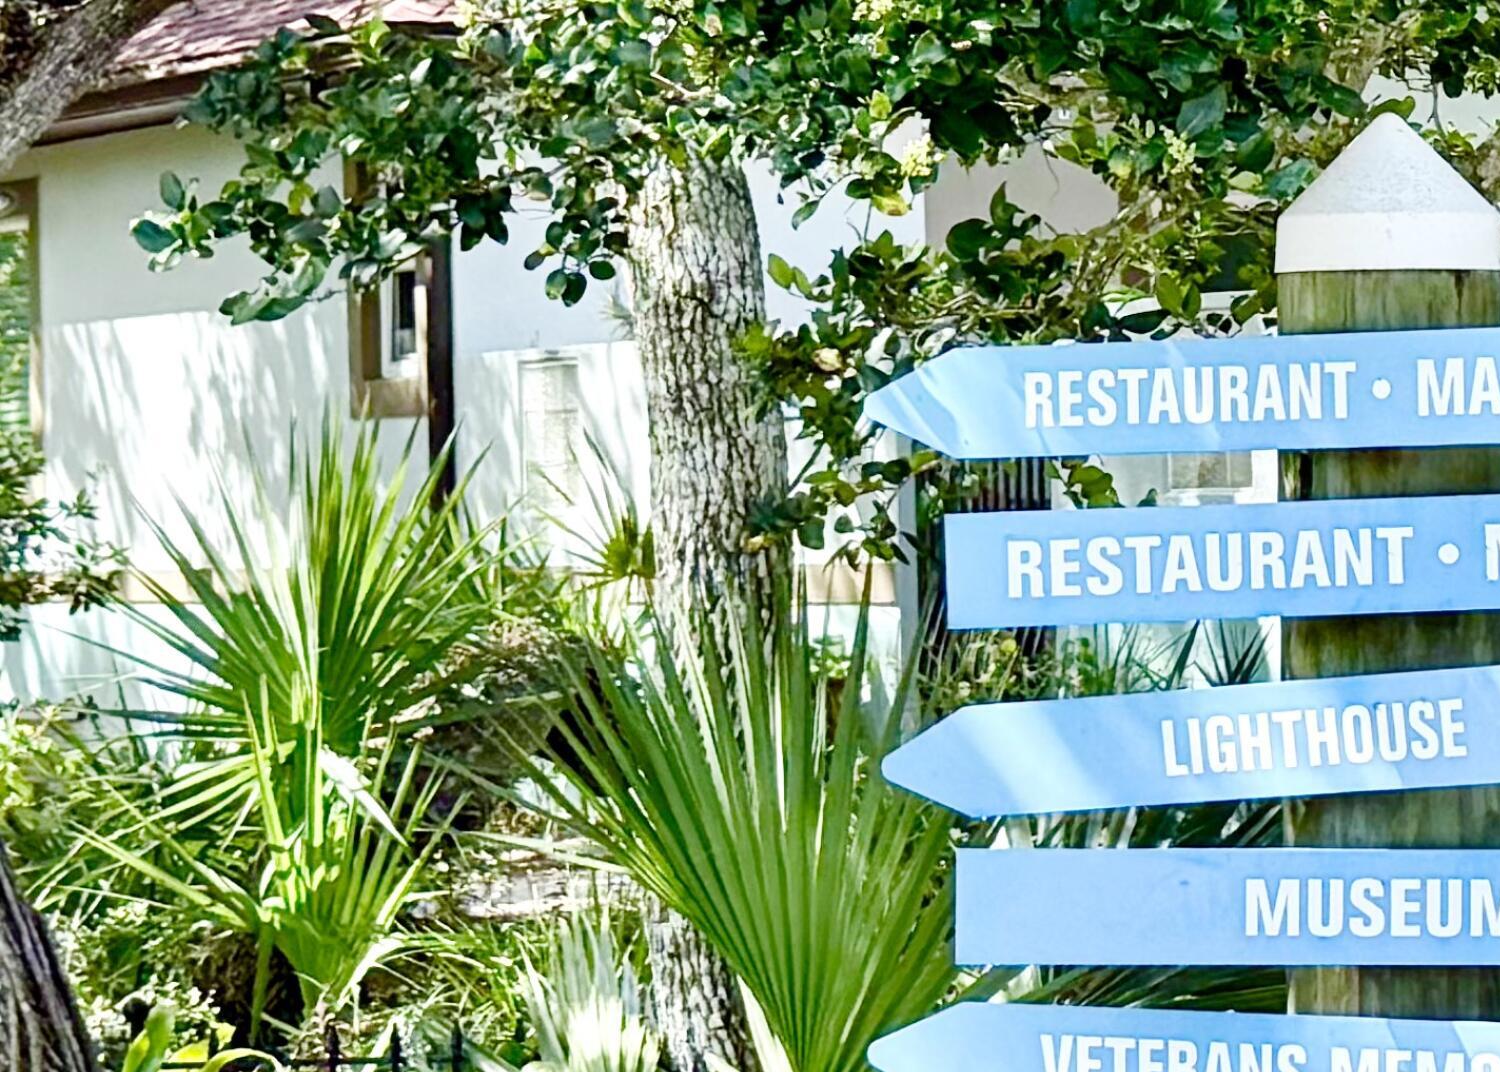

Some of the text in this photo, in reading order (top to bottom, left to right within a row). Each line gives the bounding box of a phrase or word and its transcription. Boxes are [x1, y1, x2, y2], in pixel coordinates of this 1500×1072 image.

[1023, 361, 1357, 429] RESTAURANT
[1006, 526, 1414, 598] RESTAURANT
[1161, 698, 1468, 778] LIGHTHOUSE
